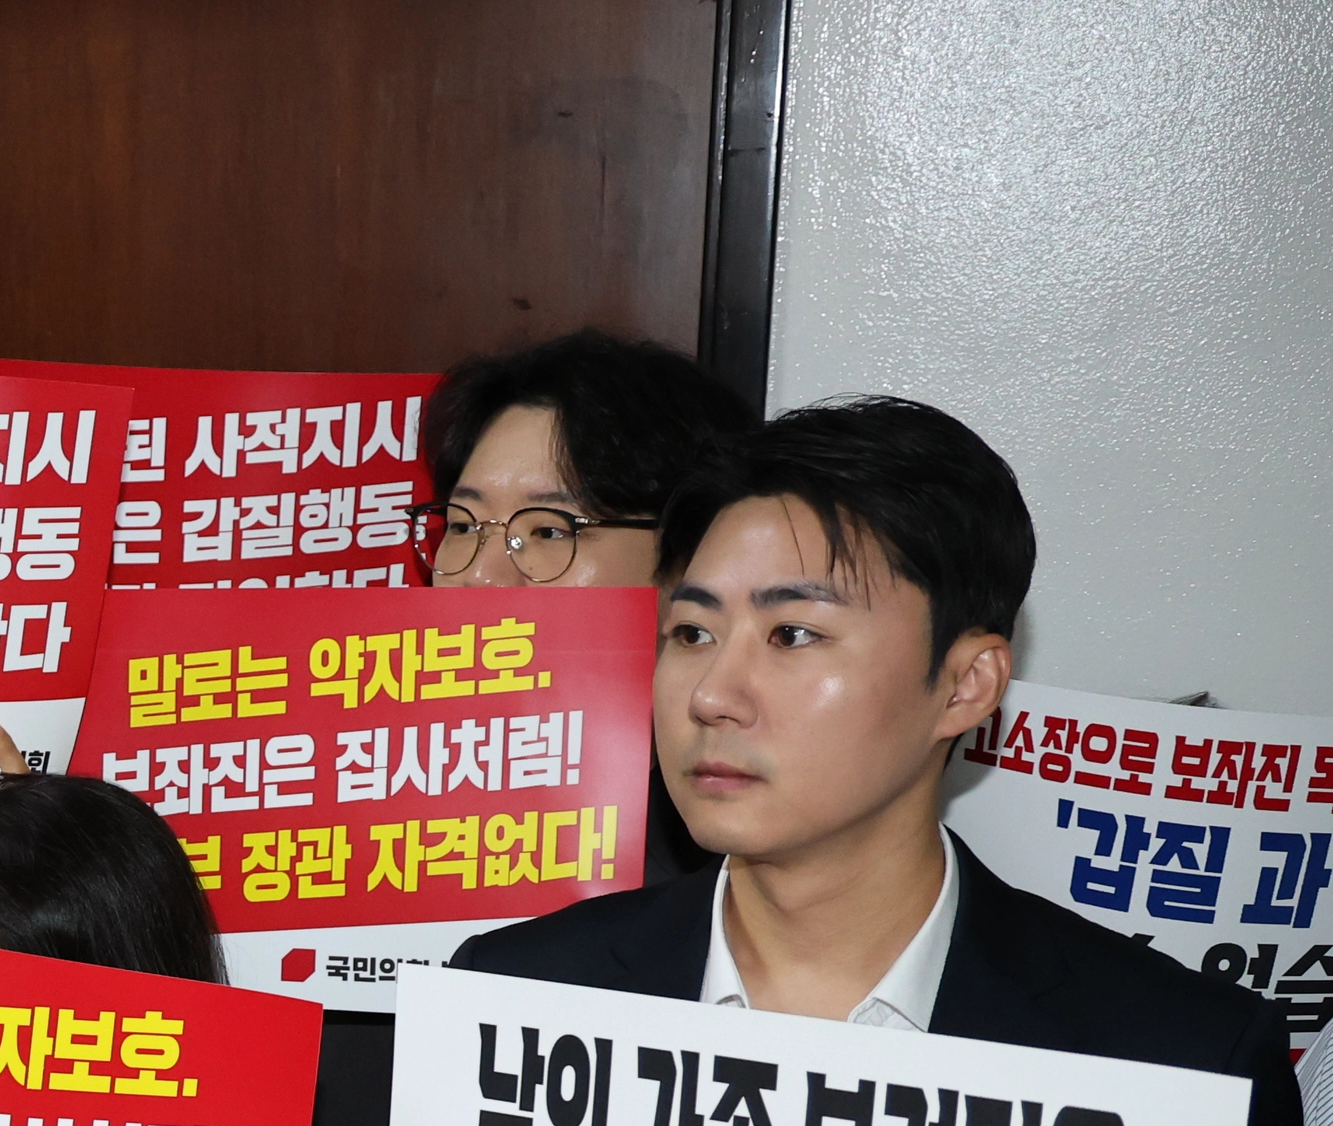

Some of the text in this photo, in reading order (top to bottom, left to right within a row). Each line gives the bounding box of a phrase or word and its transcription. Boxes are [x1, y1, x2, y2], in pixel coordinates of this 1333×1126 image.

[184, 396, 423, 479] 사적지시
[181, 480, 425, 564] 갑질행동
[128, 617, 551, 728] 말로는 약자보호.
[101, 710, 584, 818] 보좌진은 집사처럼!
[964, 706, 1159, 797] 고소장으로
[1164, 735, 1302, 812] 보좌진
[242, 824, 354, 903] 장관
[366, 804, 619, 893] 자격없다!
[1057, 798, 1231, 925] '갑질
[326, 956, 429, 984] 국민의
